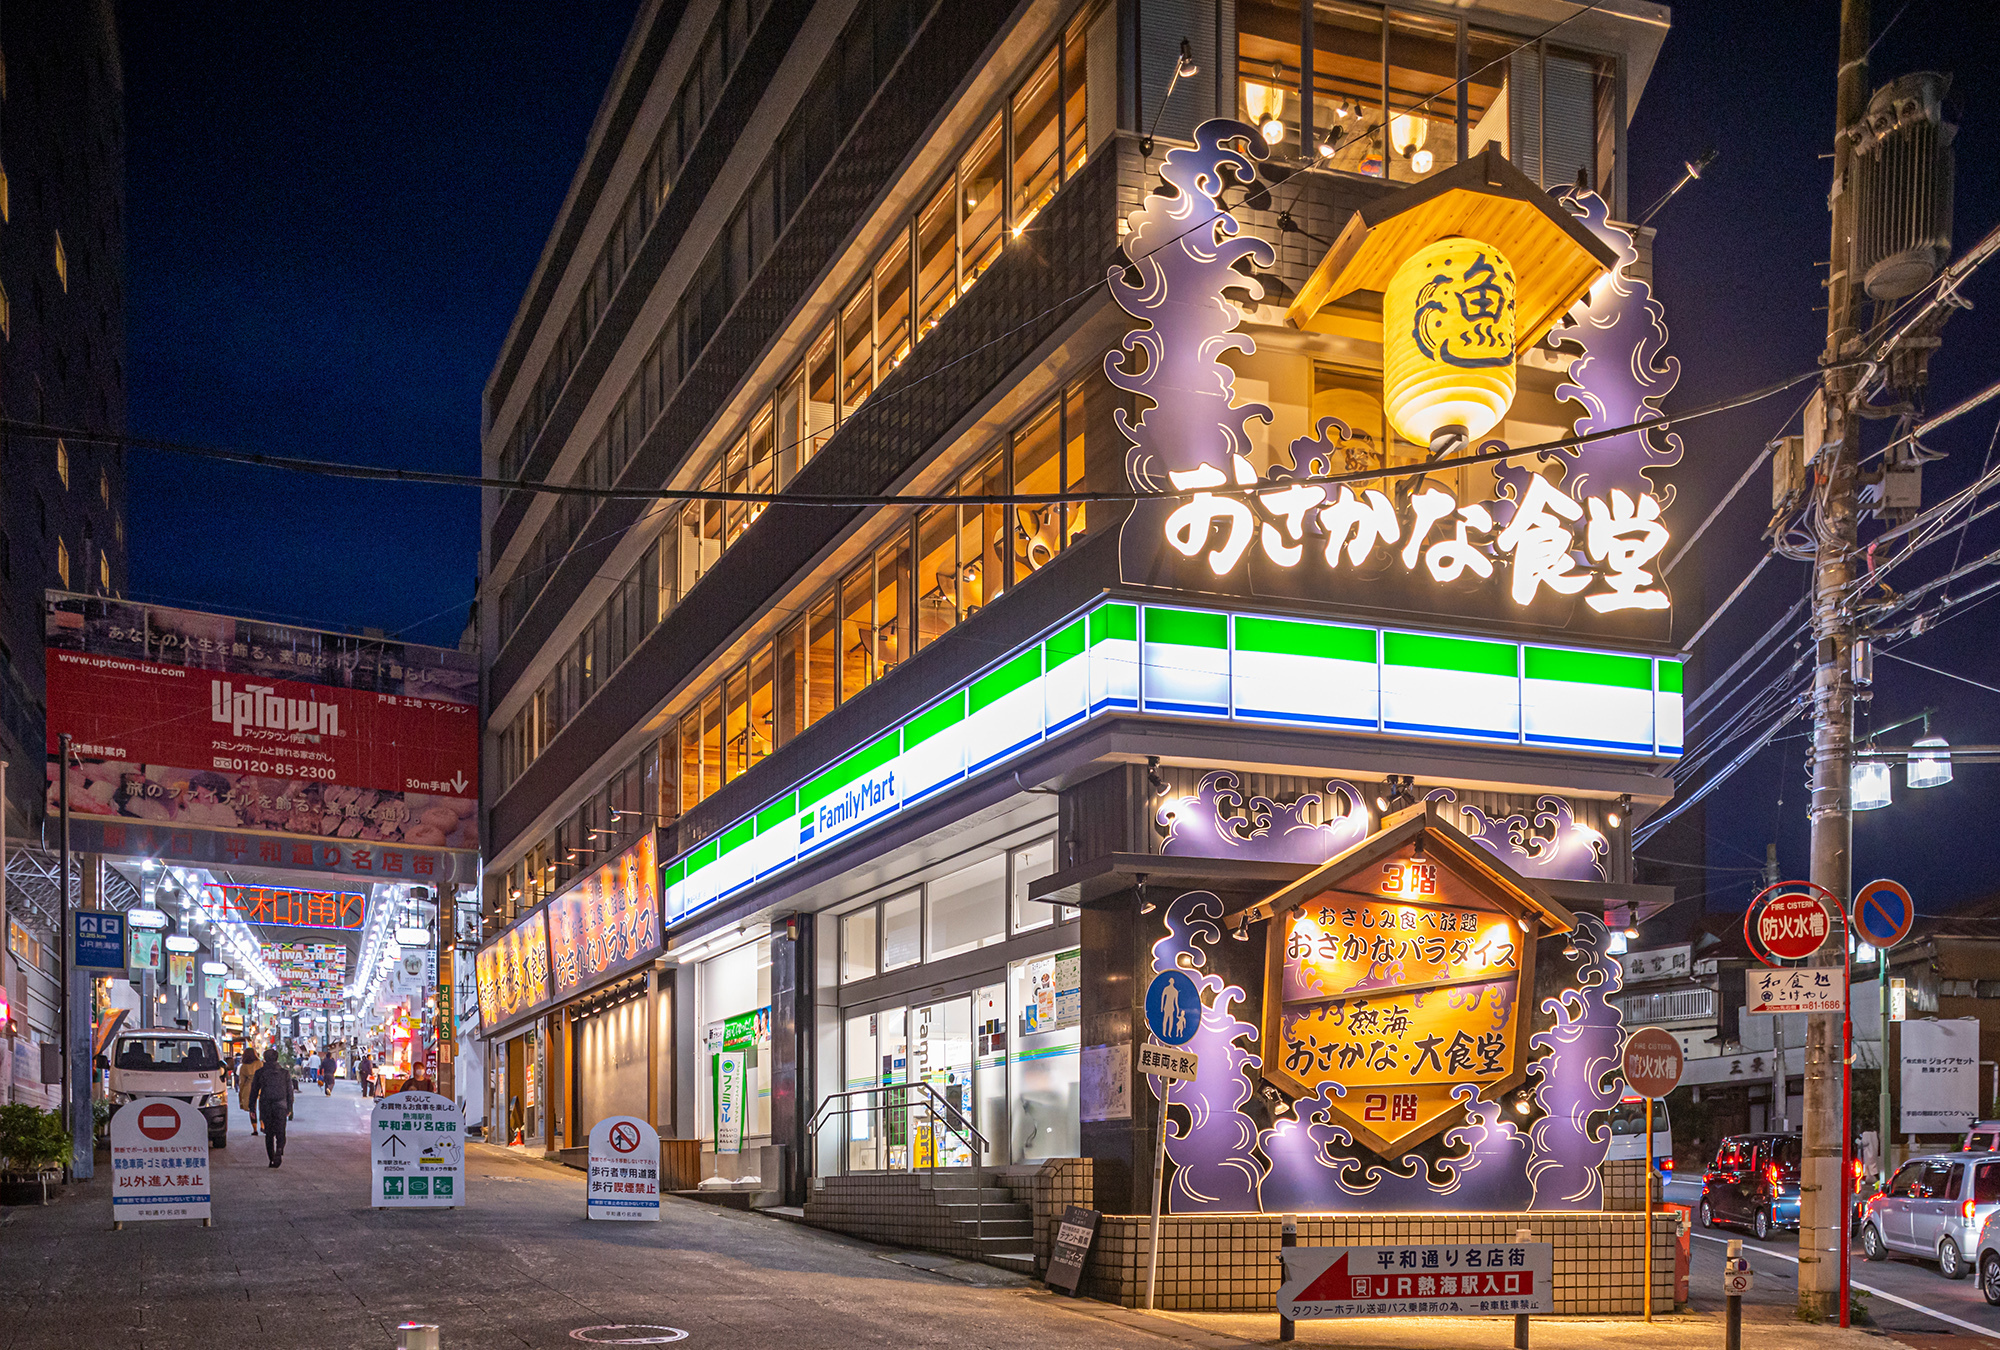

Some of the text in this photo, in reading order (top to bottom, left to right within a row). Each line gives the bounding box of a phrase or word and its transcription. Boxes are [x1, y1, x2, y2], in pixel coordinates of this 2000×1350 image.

[1164, 453, 1671, 613] おさかな食堂
[58, 652, 186, 678] www.uptown-izu.com
[820, 770, 895, 833] FamilyMart
[225, 836, 435, 877] 平和通り名店街
[1382, 862, 1437, 895] 3階
[203, 883, 366, 929] 平和通り
[1771, 900, 1814, 911] FIRE CISTERN
[1318, 906, 1478, 933] おさしみ食べ放題
[1762, 912, 1824, 942] 防火水槽
[557, 907, 654, 989] おさかなパラダイス
[1287, 931, 1517, 969] おさかなパラダイス
[1758, 971, 1831, 990] 和食処
[1808, 1000, 1840, 1010] 81-1686
[1347, 999, 1414, 1040] 熱海
[1285, 1029, 1506, 1077] おさかな・大食堂
[1648, 1043, 1672, 1051] CISTERN
[1141, 1050, 1196, 1075] 軽車両を除く
[1628, 1054, 1678, 1080] 防火水槽
[1929, 1057, 1975, 1066] ジョイアセット
[405, 1095, 431, 1103] 安心して
[721, 1075, 732, 1123] ファミマル
[1364, 1093, 1418, 1122] 2階
[378, 1120, 457, 1132] 平和通り名店街
[402, 1112, 432, 1120] 熱海駅前
[119, 1175, 204, 1188] 以外進入禁止
[591, 1166, 657, 1180] 歩行者専用道路
[592, 1181, 656, 1194] 歩行喫煙禁止
[1376, 1247, 1526, 1270] 平和通り名店街
[1376, 1274, 1521, 1297] JR熱海駅入口
[1291, 1299, 1540, 1317] タクシーホテル送迎バス乗降所の為、一般車駐車禁止
